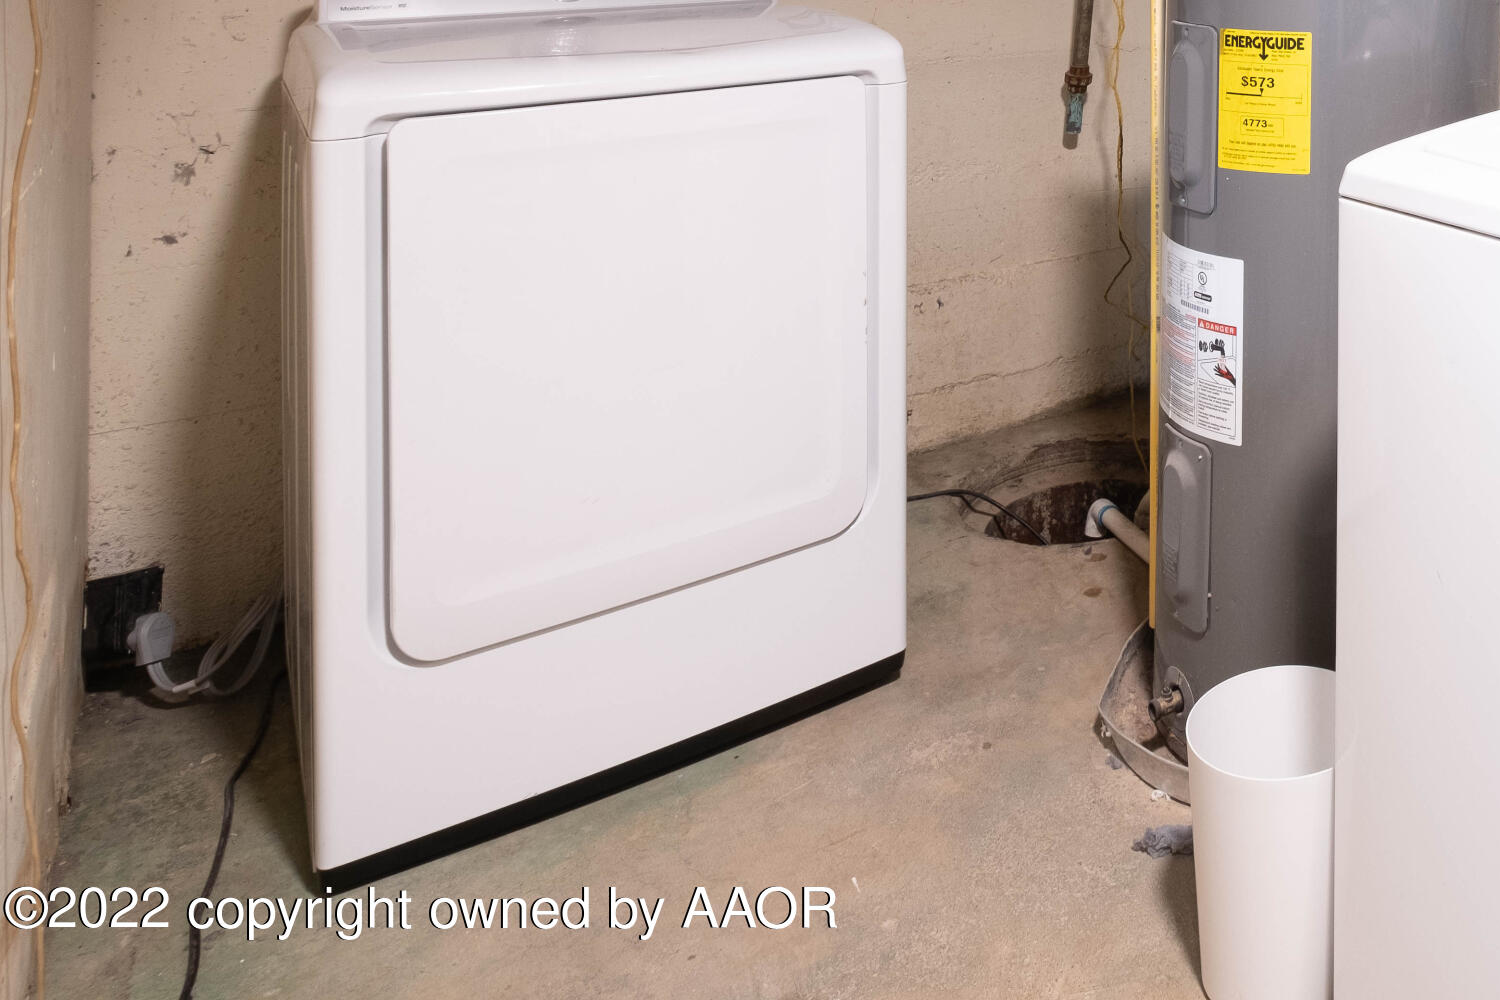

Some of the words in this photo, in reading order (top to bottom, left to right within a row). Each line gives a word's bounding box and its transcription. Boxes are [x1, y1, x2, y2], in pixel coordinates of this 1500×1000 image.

[1225, 35, 1304, 53] ENERGYGUIDE
[1241, 76, 1274, 88] $573
[1243, 119, 1267, 128] 4773
[1206, 323, 1235, 335] DANGER
